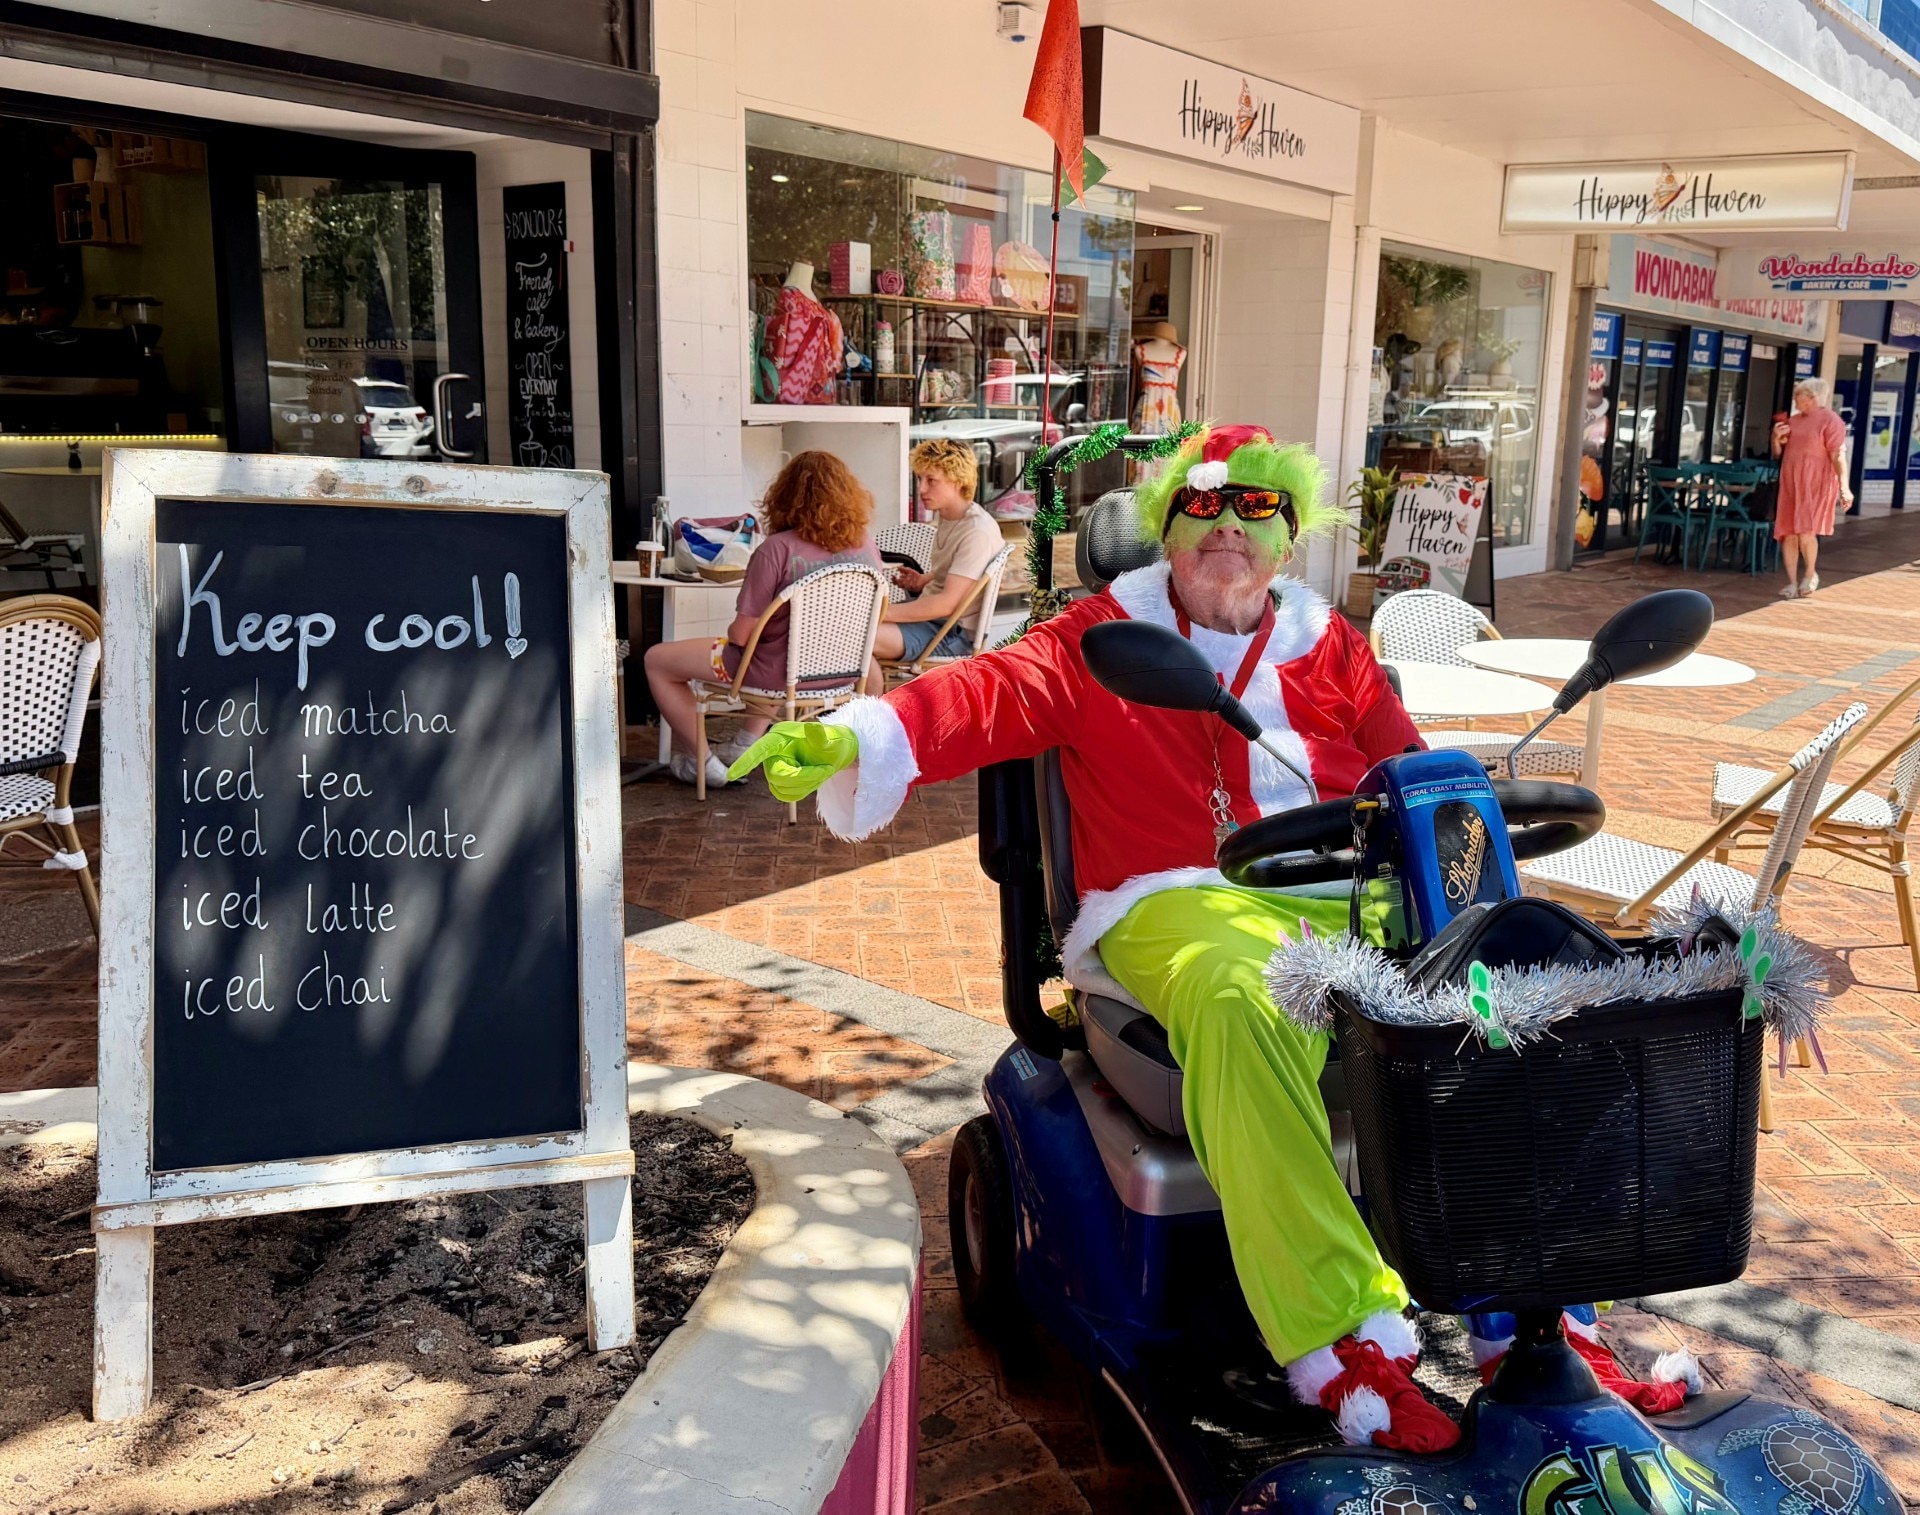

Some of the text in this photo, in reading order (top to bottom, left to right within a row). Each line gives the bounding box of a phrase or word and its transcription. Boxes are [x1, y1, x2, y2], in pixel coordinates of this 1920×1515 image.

[1178, 80, 1306, 158] Hippy Haven
[1573, 173, 1765, 225] Hippy Haven
[511, 209, 558, 239] BONJOUR
[515, 252, 554, 296] French
[1635, 250, 1719, 309] WONDABAK
[1760, 253, 1919, 279] Wondabake
[1802, 281, 1836, 290] BAKERY
[1839, 280, 1846, 290] &
[306, 337, 408, 351] OPEN HOURS
[514, 314, 565, 353] & bakery
[520, 378, 558, 395] EVERYDAY
[525, 352, 552, 379] OPEN
[1396, 493, 1456, 533] Hippy
[1405, 523, 1467, 555] Haven
[177, 543, 528, 690] Keep cool!
[181, 677, 456, 738] iced matcha
[182, 746, 373, 803] iced tea
[1405, 788, 1428, 799] CORAL
[1430, 784, 1453, 793] COAST
[1454, 782, 1488, 791] MOBILITY
[181, 805, 484, 860] iced chocolate
[183, 877, 397, 933] iced latte
[183, 951, 391, 1020] iced chai
